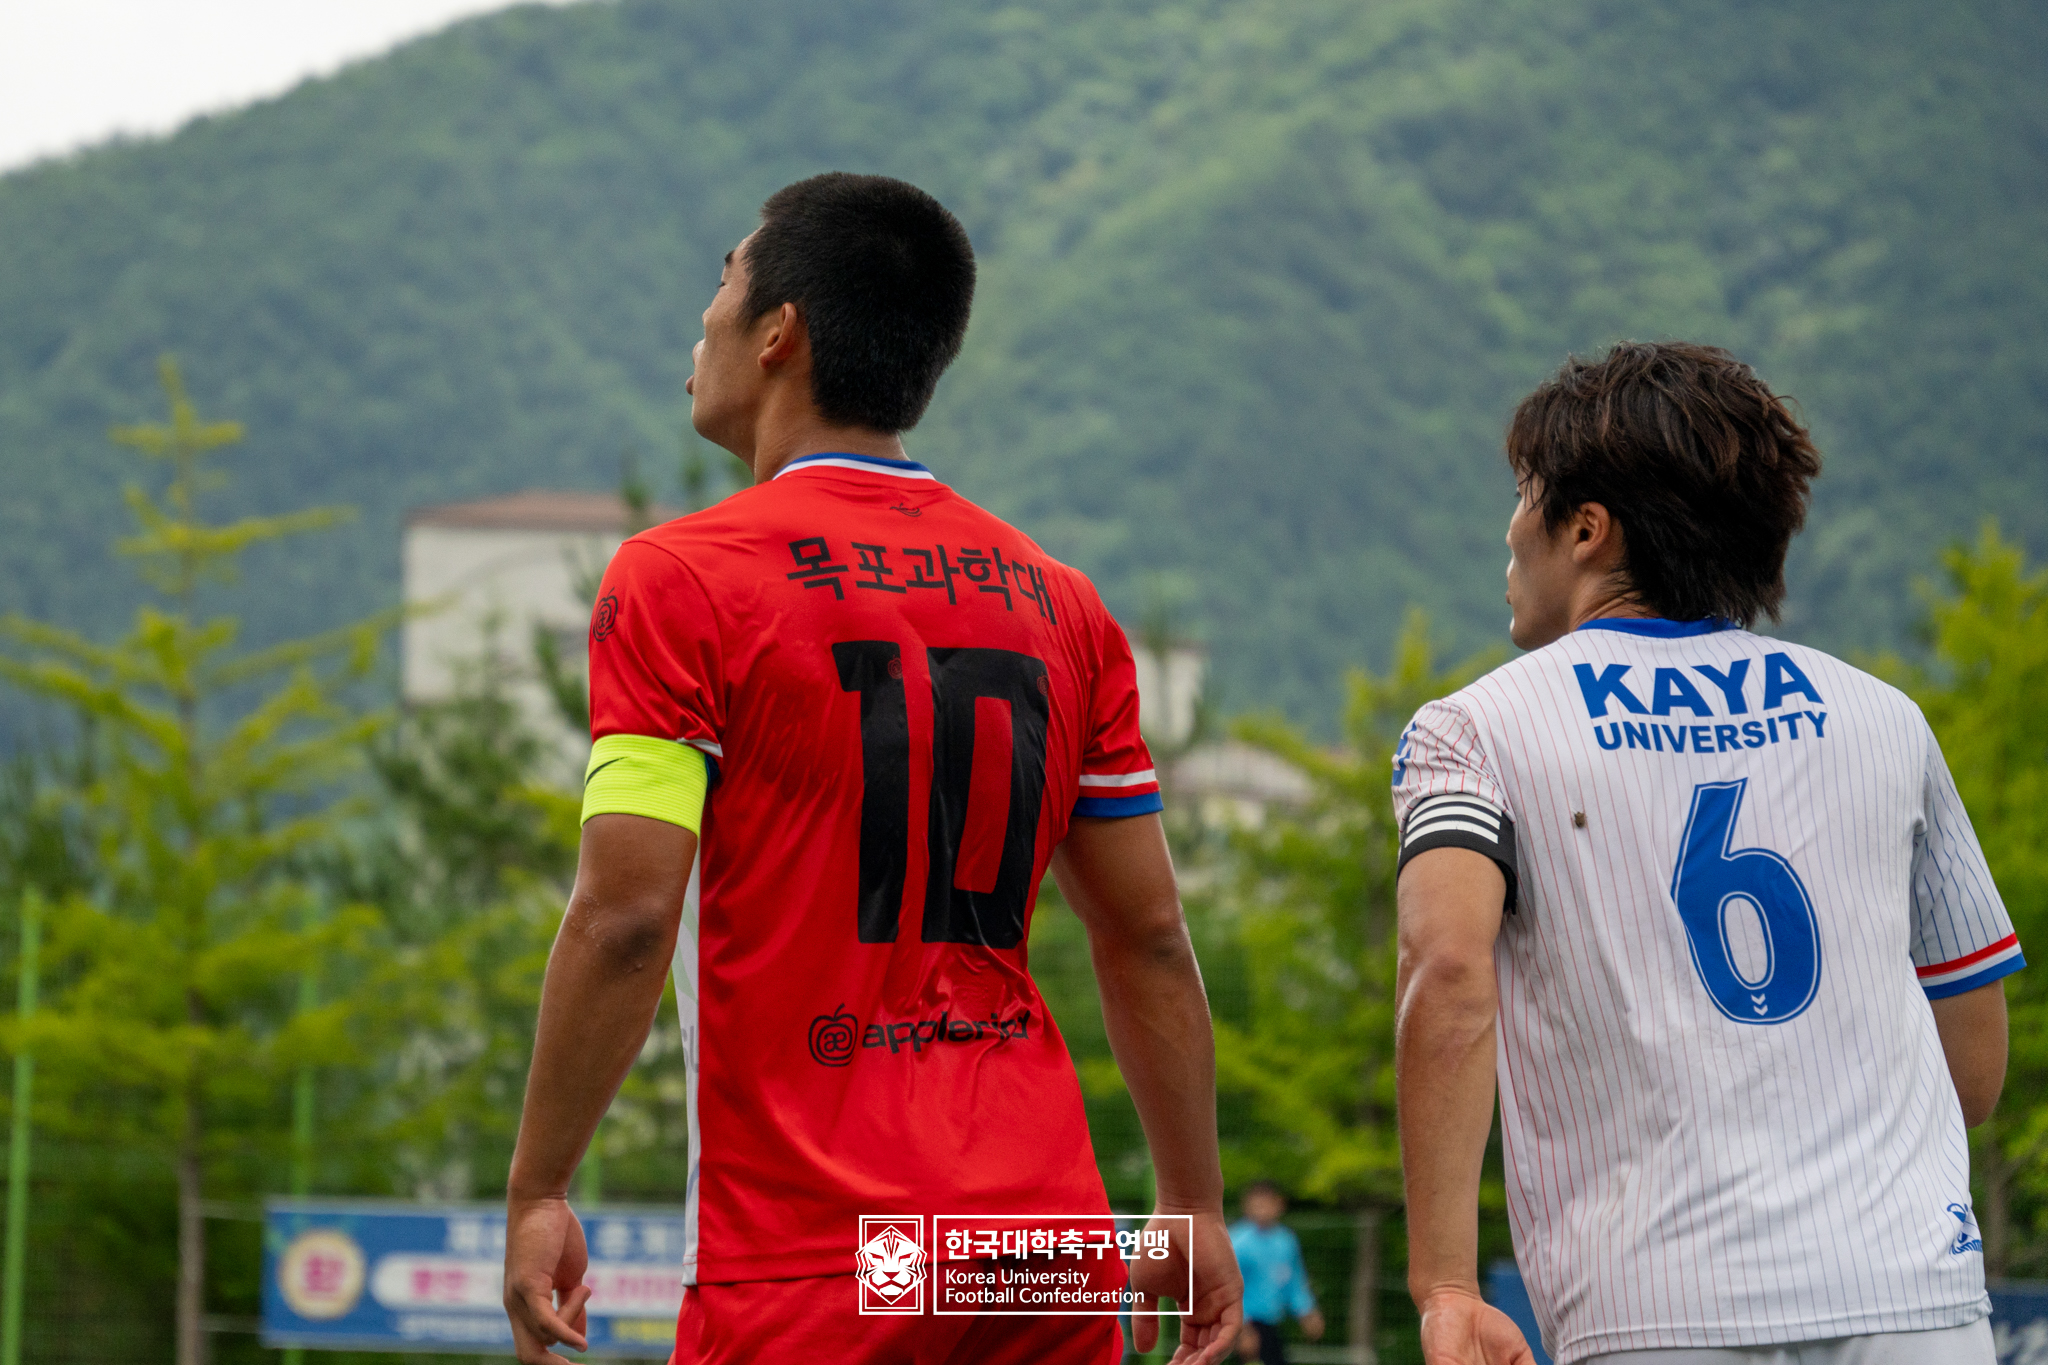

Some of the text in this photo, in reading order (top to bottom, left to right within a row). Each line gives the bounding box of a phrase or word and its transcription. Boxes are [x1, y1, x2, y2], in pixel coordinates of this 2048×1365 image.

[786, 536, 1058, 626] 목포과학대
[1572, 651, 1825, 719] KAYA
[1594, 711, 1829, 754] UNIVERSITY
[831, 640, 1049, 949] 10
[1670, 777, 1822, 1026] 6
